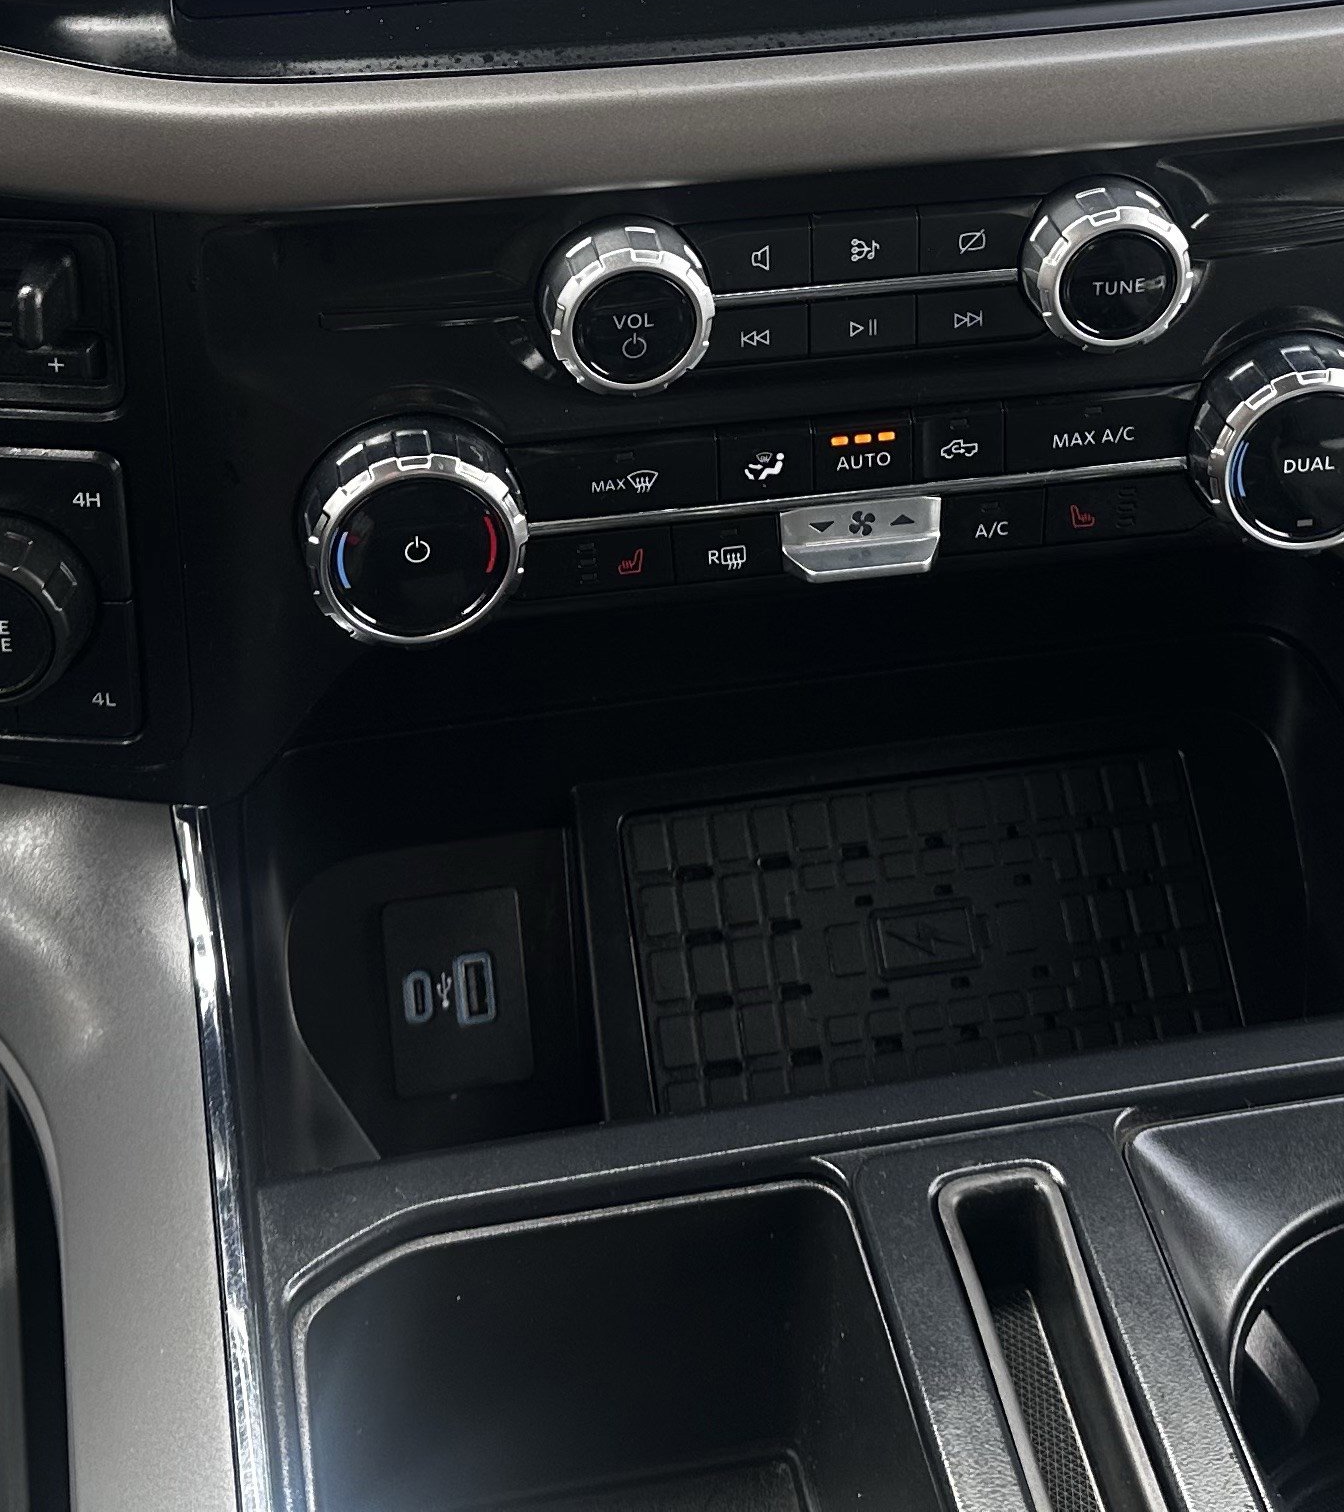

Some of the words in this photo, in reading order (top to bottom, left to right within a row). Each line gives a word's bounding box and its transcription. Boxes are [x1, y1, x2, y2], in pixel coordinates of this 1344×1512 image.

[1092, 277, 1147, 297] TUNE
[612, 313, 655, 330] VOL
[1052, 431, 1097, 450] MAX
[1101, 426, 1136, 445] A/C
[836, 451, 892, 471] AUTO
[1283, 454, 1335, 475] DUAL
[591, 478, 626, 494] MAX
[72, 491, 101, 509] 4H
[974, 520, 1009, 540] A/C
[708, 550, 720, 565] R
[91, 691, 117, 708] 4L
